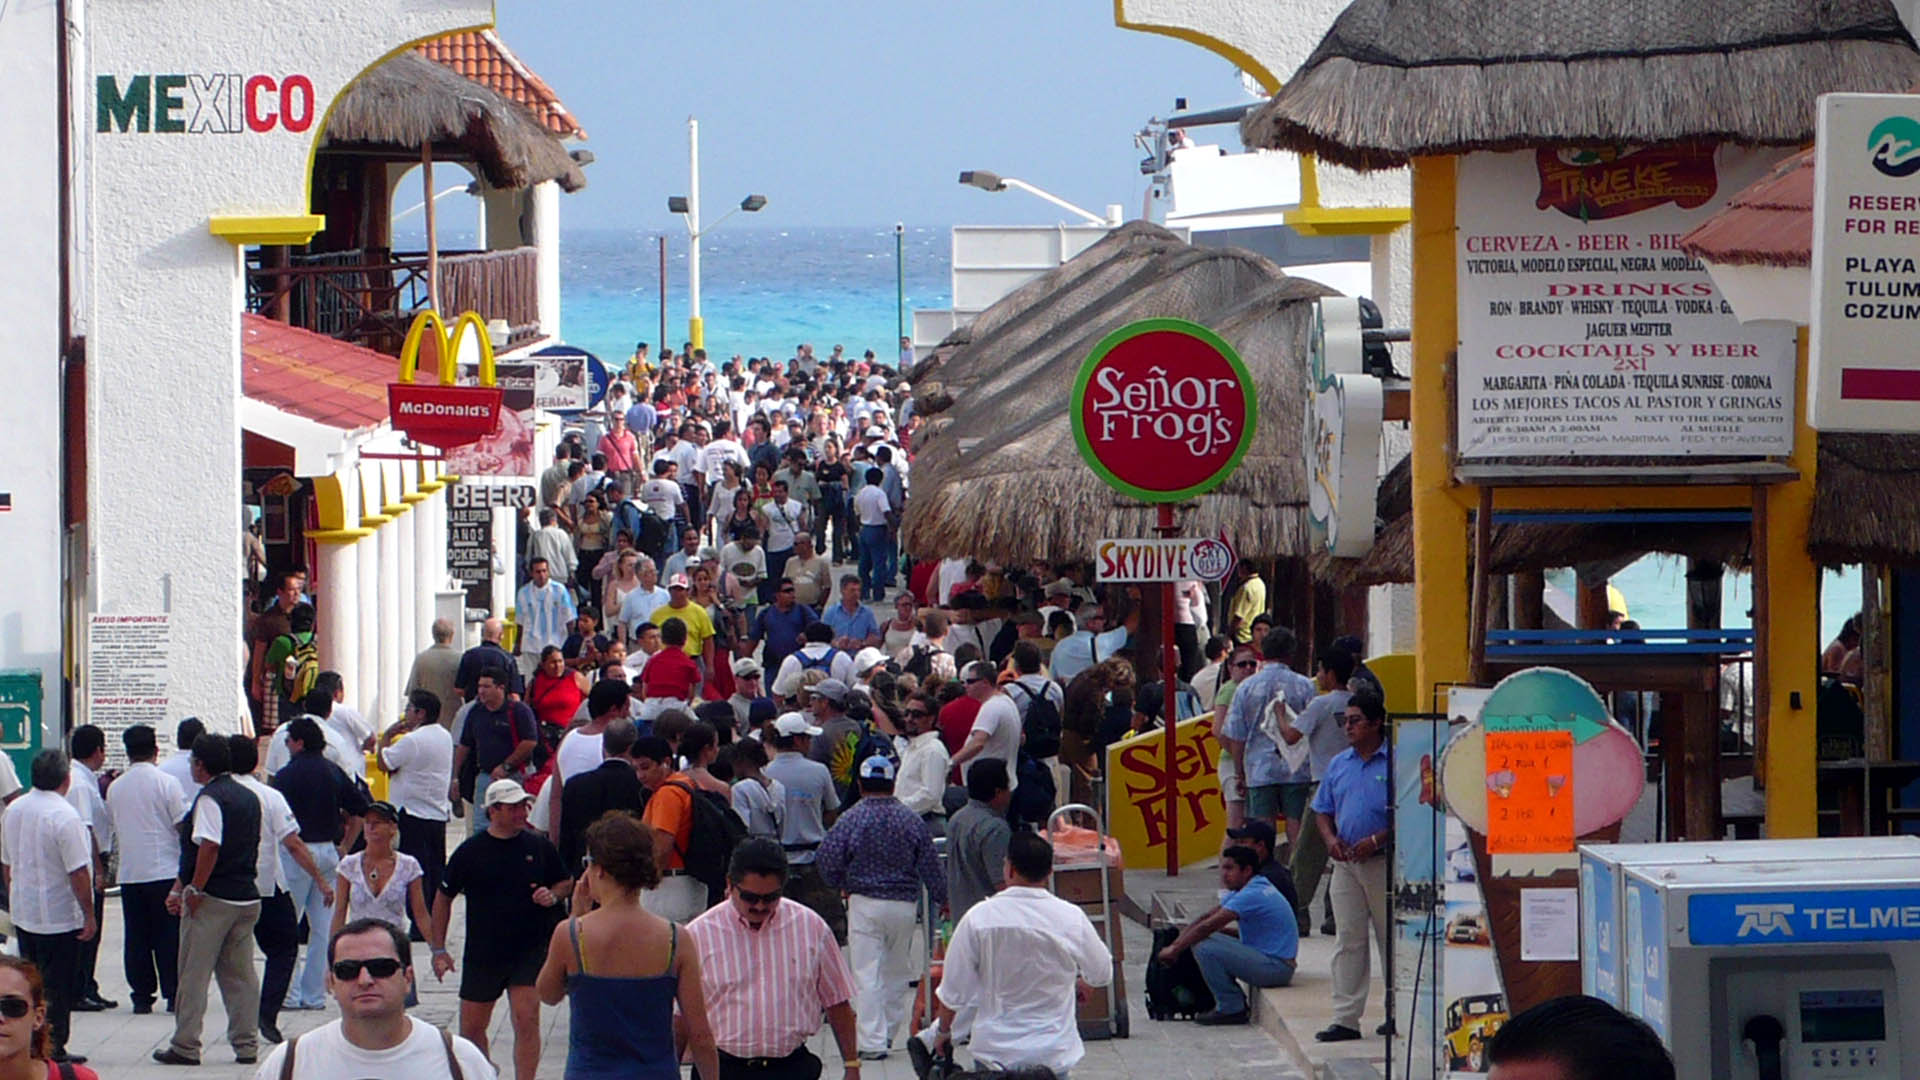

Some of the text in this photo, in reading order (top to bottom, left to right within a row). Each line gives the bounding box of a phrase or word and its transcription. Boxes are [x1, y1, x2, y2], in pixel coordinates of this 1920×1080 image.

[97, 74, 314, 133] MEXICO
[1849, 195, 1920, 211] RESER
[1845, 218, 1920, 235] FOR RE
[1466, 234, 1683, 253] CERVEZA BEER BIE
[1467, 259, 1518, 276] VICTORIA,
[1520, 258, 1565, 273] MODELO
[1567, 258, 1618, 274] ESPECIAL,
[1620, 257, 1656, 272] NEGRA
[1846, 257, 1916, 273] PLAYA
[1548, 283, 1713, 297] DRINKS
[1490, 302, 1512, 316] RON
[1519, 301, 1564, 316] BRANDY
[1571, 301, 1614, 315] WHISKY
[1622, 300, 1668, 317] TEQUILA
[1675, 300, 1713, 314] VODKA
[1844, 303, 1920, 320] COZUM
[1586, 323, 1627, 340] JAGUER
[1496, 343, 1759, 360] COCKTAILS Y BEER
[1093, 366, 1235, 412] Señor
[1483, 376, 1547, 391] MARGARITA
[1582, 375, 1625, 389] COLADA
[1633, 375, 1680, 391] TEQUILA
[1682, 375, 1724, 389] SUNRISE
[1731, 375, 1773, 389] CORONA
[399, 401, 490, 417] McDonald's
[1472, 396, 1783, 412] LOS MEJORES TACOS AL PASTOR Y GRINGAS
[1471, 414, 1618, 425] ABIERTO TODOS LOS DIAS
[1634, 415, 1663, 424] NEXT
[1668, 415, 1684, 424] TO
[1687, 415, 1711, 424] THE
[1713, 415, 1746, 424] DOCK
[1099, 409, 1232, 457] Frog's
[1680, 424, 1742, 433] AL MUELLE
[453, 485, 522, 508] BEER
[448, 548, 489, 561] OCKERS
[1100, 541, 1188, 579] SKYDIVE
[116, 615, 168, 623] IMPORTANTE
[1802, 906, 1920, 930] TELME
